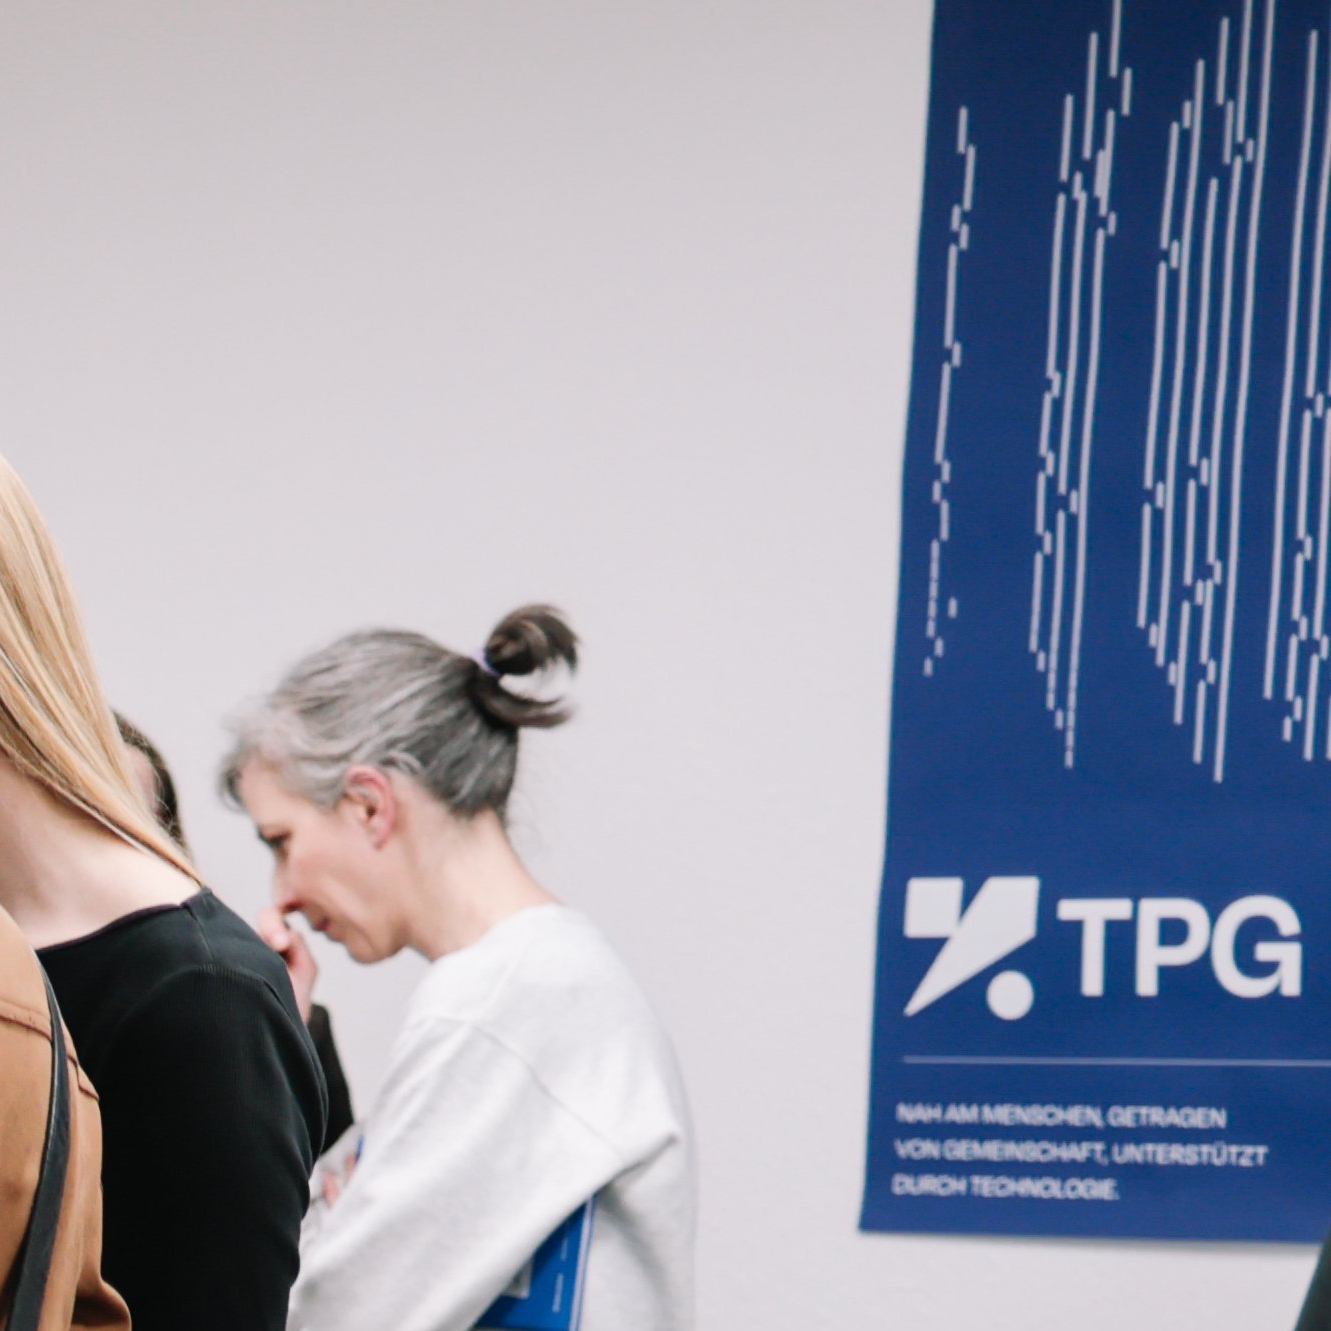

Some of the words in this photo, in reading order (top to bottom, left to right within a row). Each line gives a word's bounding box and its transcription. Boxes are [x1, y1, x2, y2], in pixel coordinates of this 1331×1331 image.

[1056, 894, 1303, 999] TPG
[895, 1102, 942, 1125] NAH
[944, 1103, 979, 1125] AM
[982, 1103, 1104, 1129] MENSCHEN,
[1107, 1105, 1227, 1129] GETRAGEN
[894, 1137, 941, 1161] VON
[943, 1138, 1109, 1167] GEMEINSCHAFT,
[1111, 1140, 1269, 1168] UNTERSTÜTZT
[891, 1172, 967, 1197] DURCH
